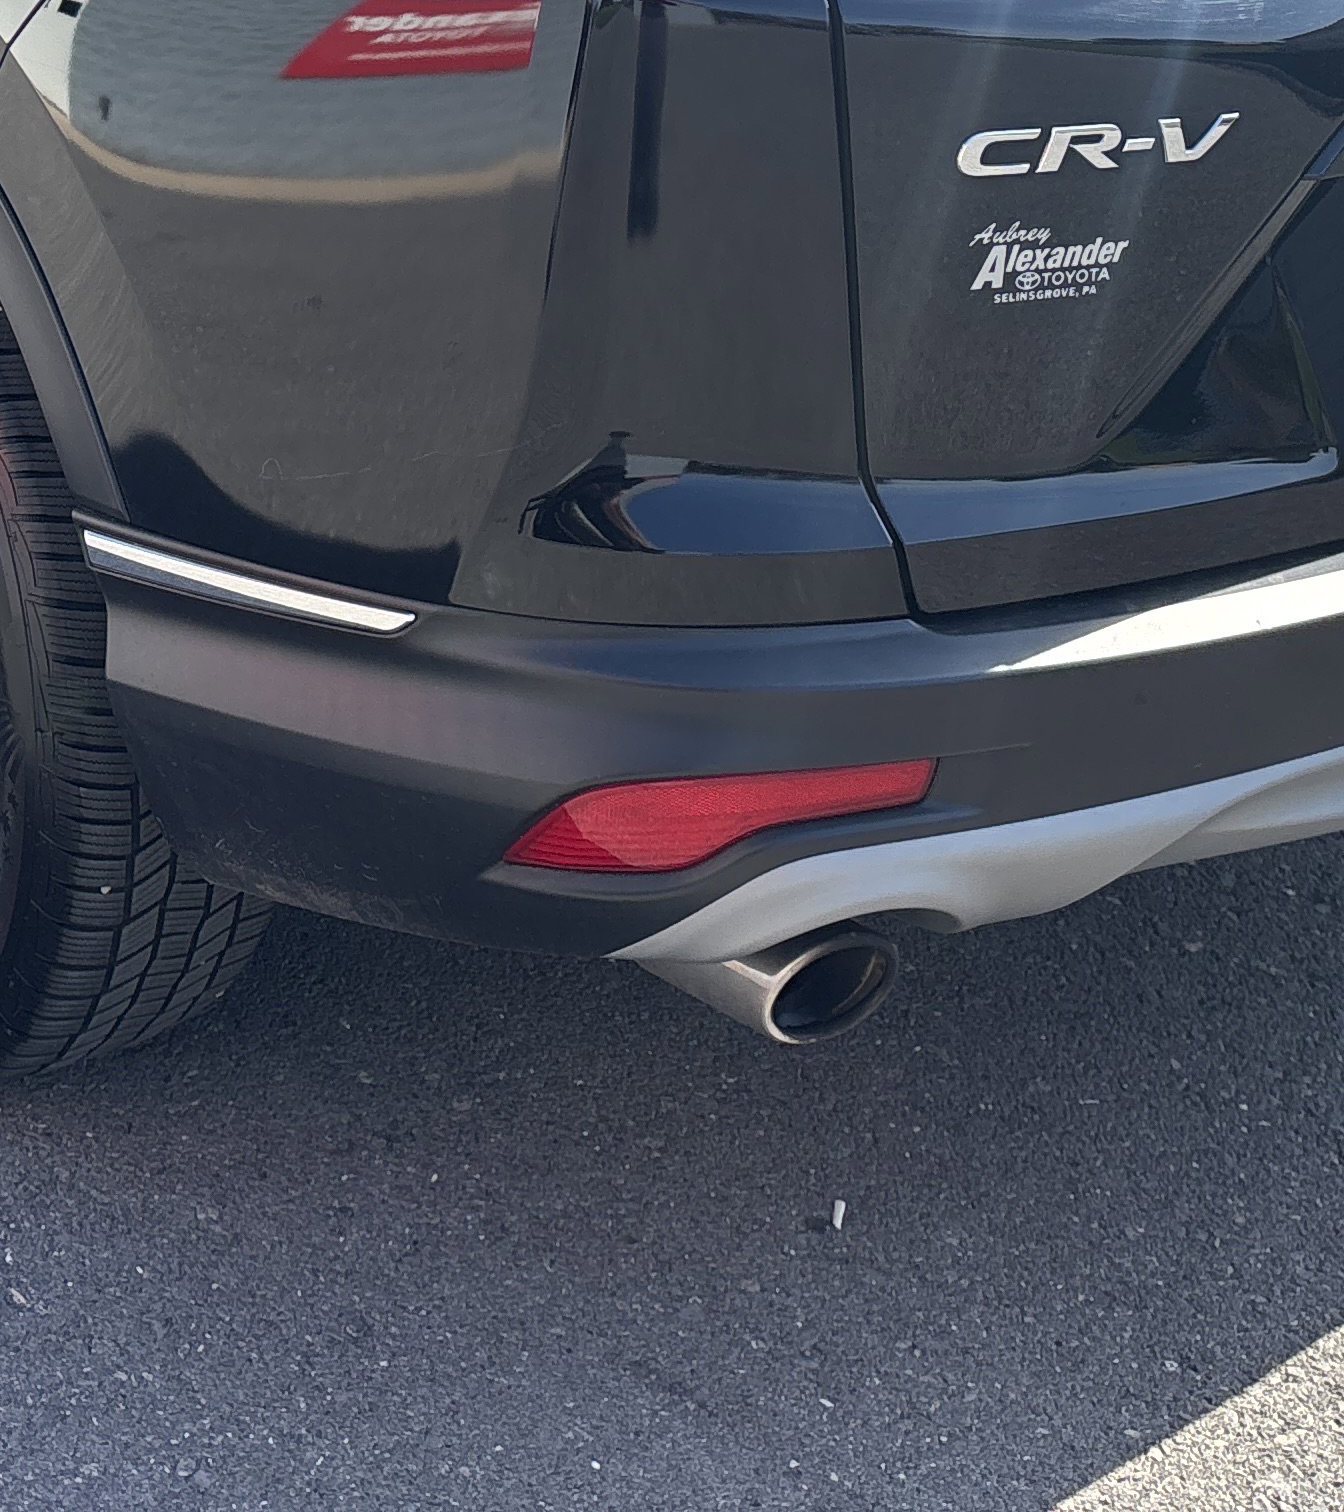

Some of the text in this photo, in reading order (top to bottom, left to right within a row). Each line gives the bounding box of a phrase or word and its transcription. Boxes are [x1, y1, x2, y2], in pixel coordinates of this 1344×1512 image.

[956, 111, 1240, 177] CR-V
[968, 220, 1052, 247] Aubrey
[969, 236, 1130, 291] Alexander
[1042, 266, 1111, 286] TOYOTA
[993, 284, 1098, 304] SELINSGROVE, PA
